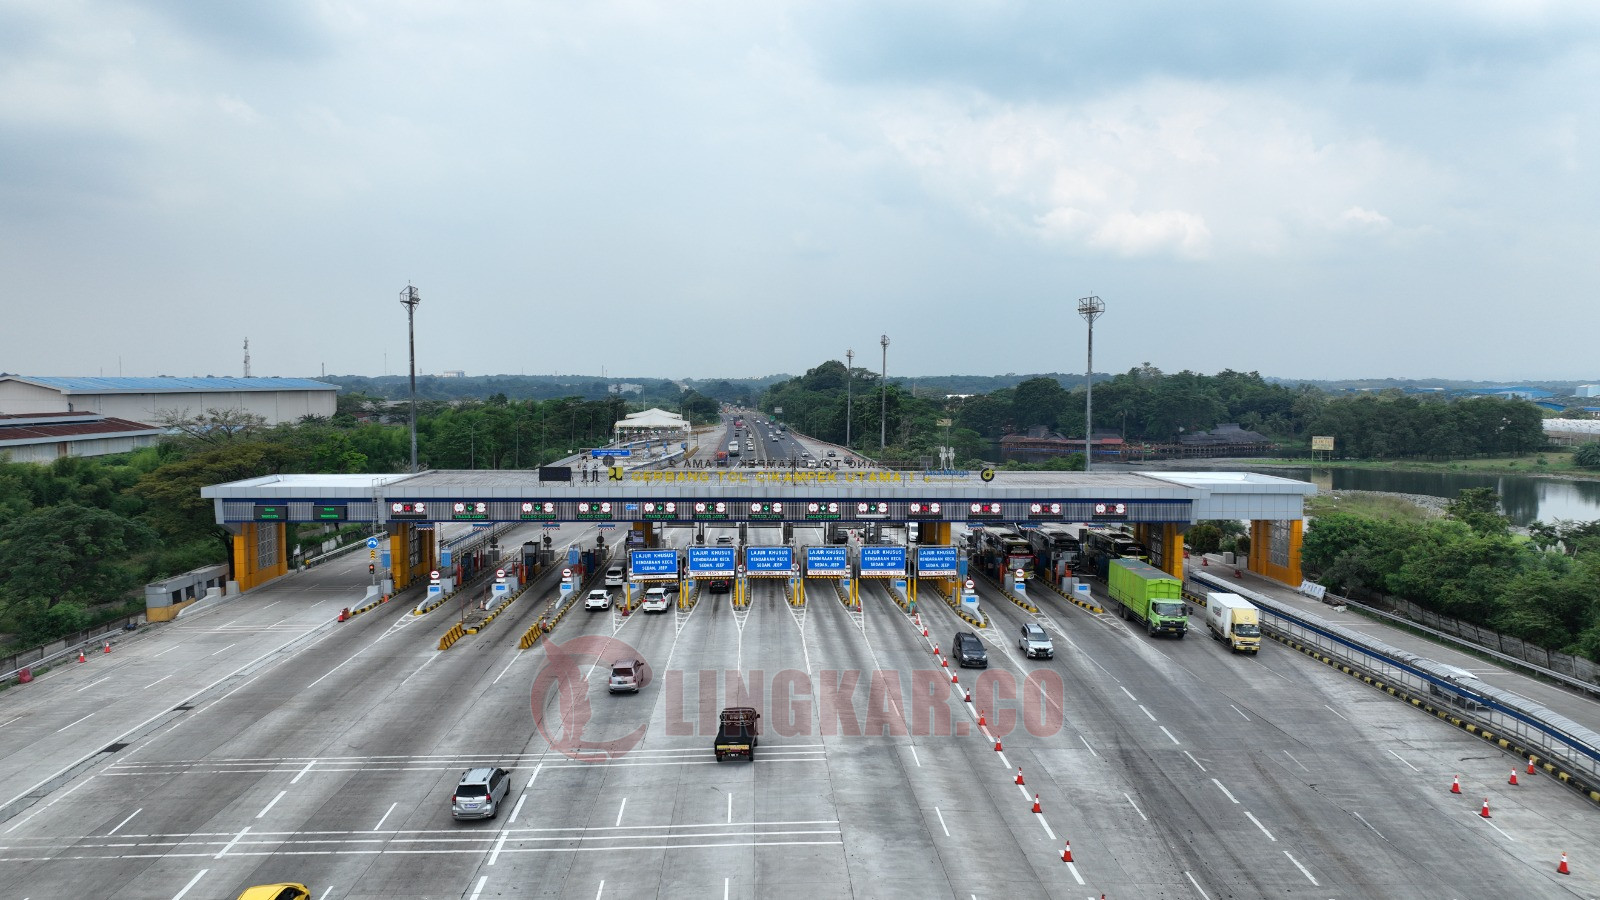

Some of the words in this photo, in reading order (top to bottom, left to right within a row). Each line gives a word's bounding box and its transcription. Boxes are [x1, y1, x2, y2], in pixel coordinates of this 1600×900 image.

[631, 471, 710, 482] GERBANG
[717, 471, 748, 482] TOL
[756, 472, 837, 482] CIKAMPEK
[845, 472, 901, 482] UTAMA
